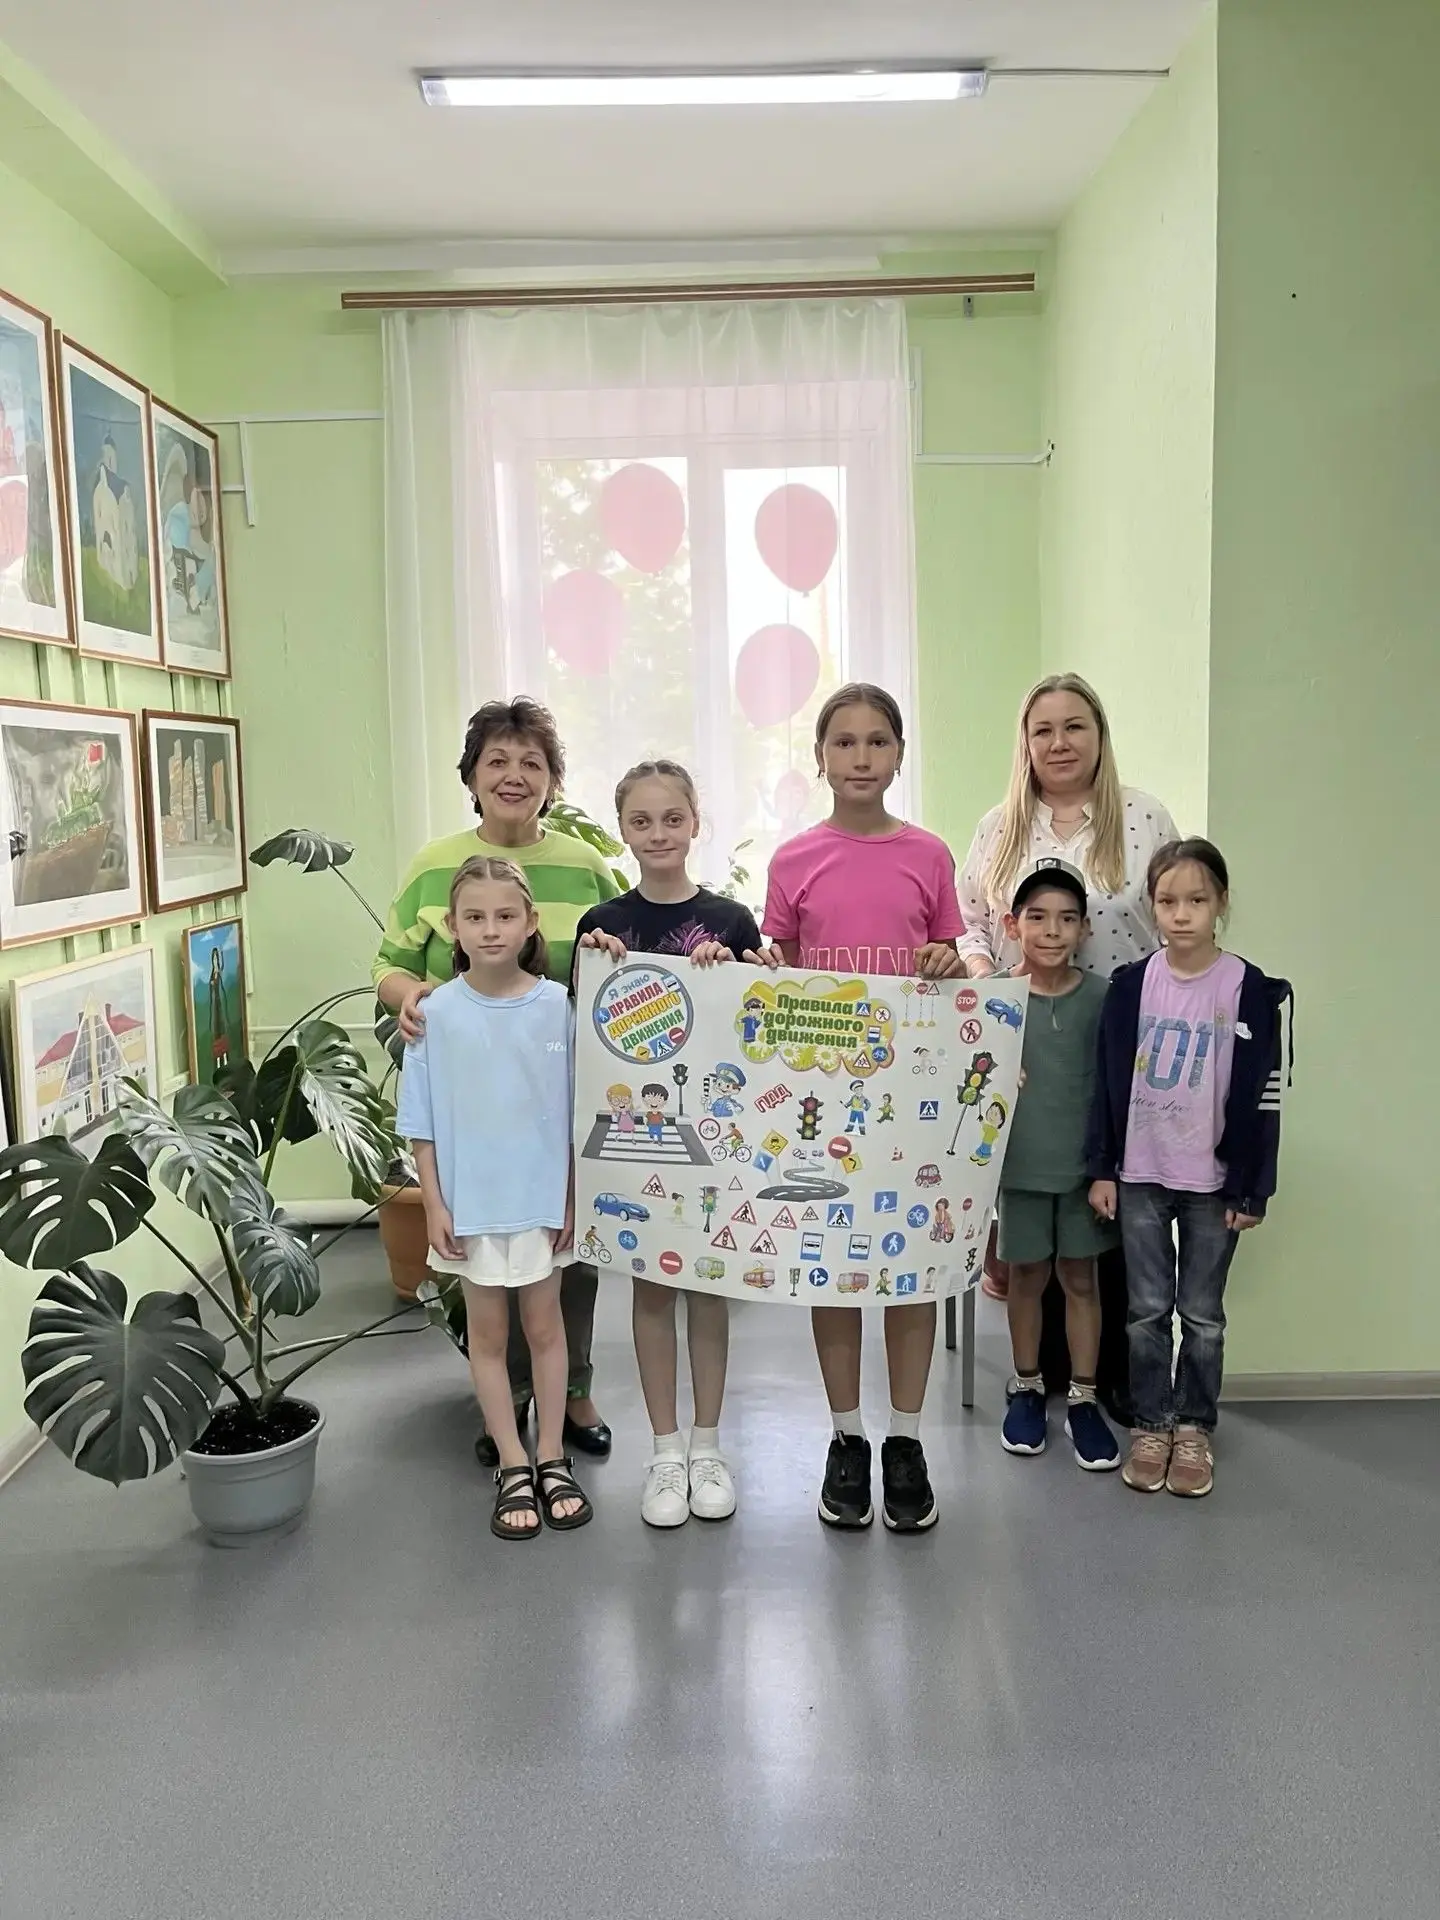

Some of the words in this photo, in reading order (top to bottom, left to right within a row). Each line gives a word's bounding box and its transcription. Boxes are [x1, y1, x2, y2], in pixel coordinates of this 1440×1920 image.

[608, 988, 619, 1000] Я
[621, 974, 650, 993] знаю
[608, 982, 664, 1018] ПРАВИЛА
[777, 994, 853, 1015] Правила
[957, 996, 977, 1005] STOP
[607, 991, 681, 1040] ДОРОЖНОГО
[763, 1011, 864, 1032] дорожного
[621, 1009, 685, 1052] ДВИЖЕНИЯ
[766, 1028, 857, 1048] движения
[754, 1084, 793, 1113] ПДД
